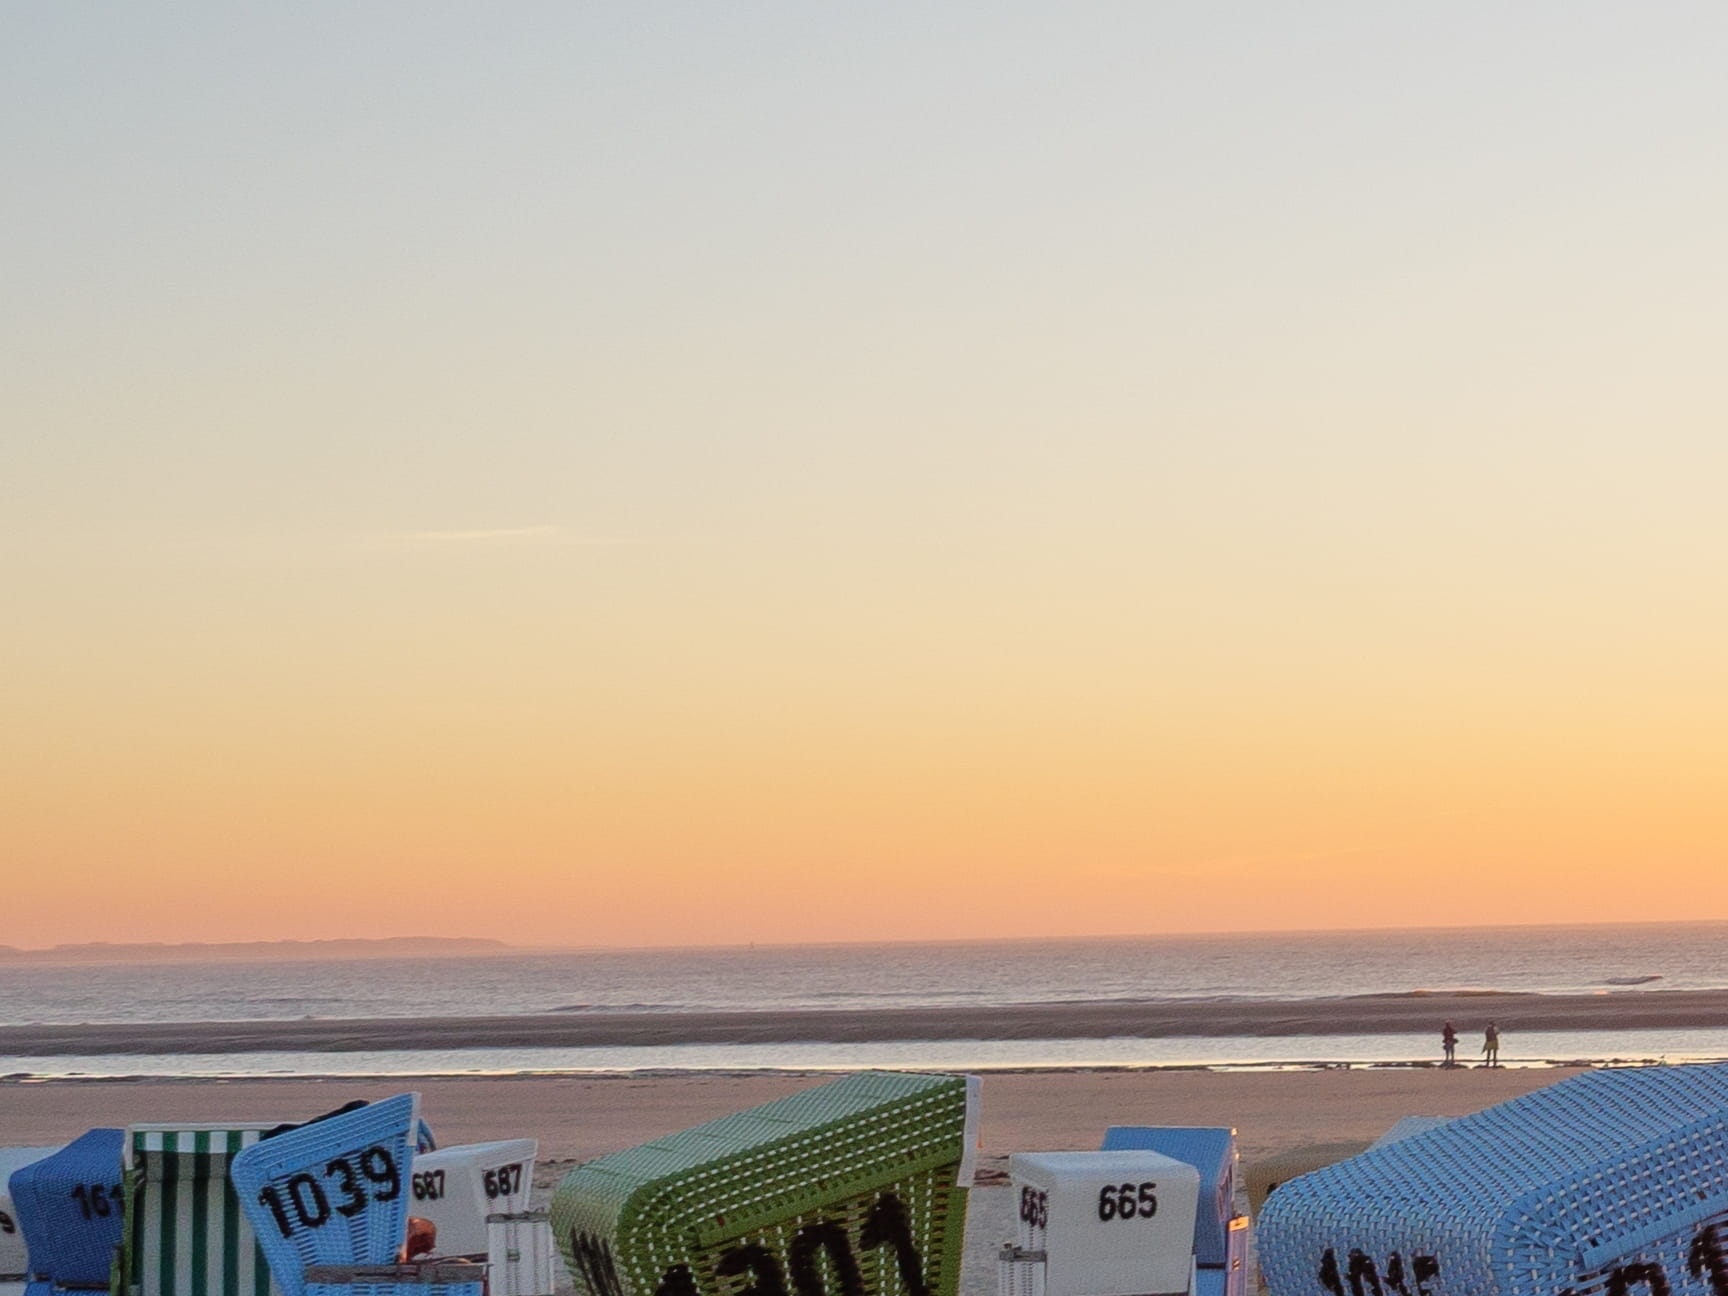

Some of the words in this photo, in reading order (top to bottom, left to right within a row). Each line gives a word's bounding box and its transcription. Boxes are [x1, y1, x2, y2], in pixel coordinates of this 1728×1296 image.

[257, 1145, 401, 1239] 1039
[412, 1169, 446, 1201] 687
[482, 1163, 523, 1200] 687
[1098, 1182, 1157, 1222] 665
